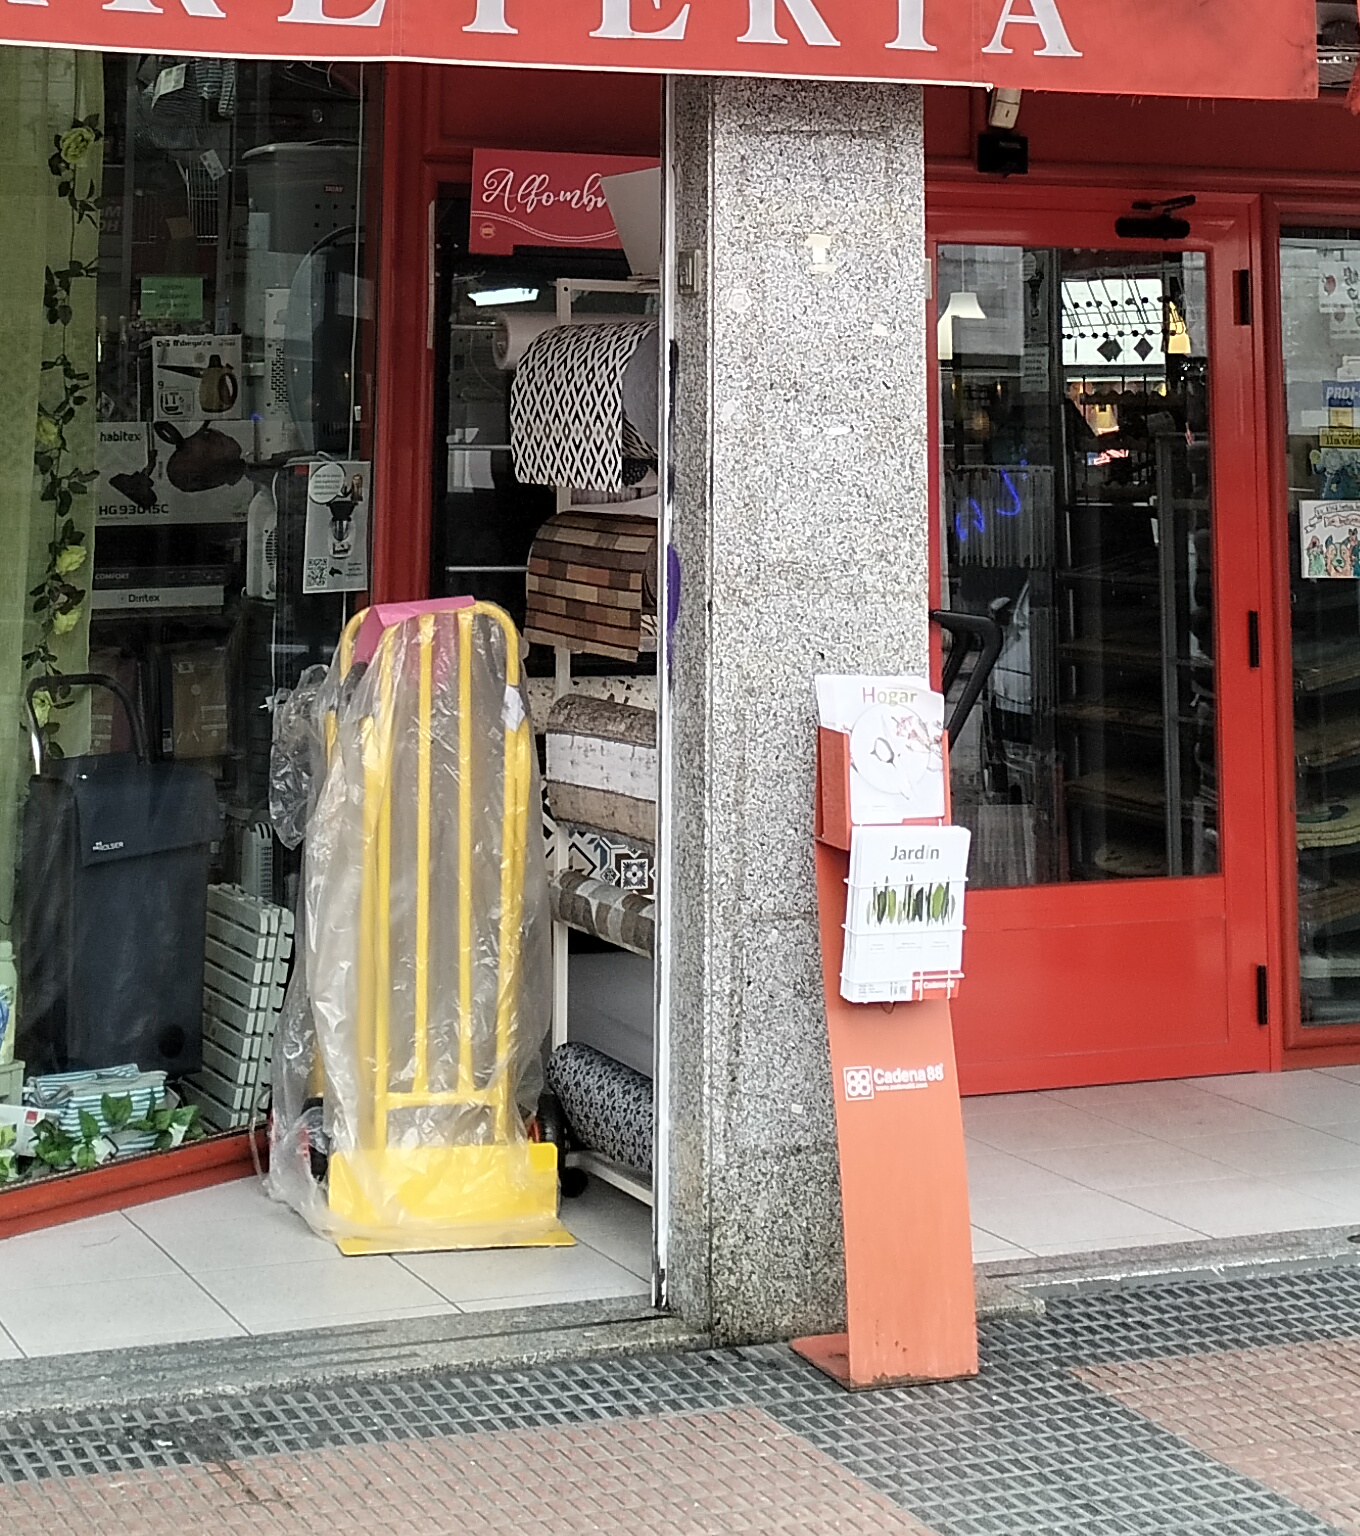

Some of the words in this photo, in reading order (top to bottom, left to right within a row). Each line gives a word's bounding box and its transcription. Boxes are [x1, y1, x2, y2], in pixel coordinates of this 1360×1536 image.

[482, 168, 607, 214] Alfombr
[99, 427, 141, 442] habitex
[862, 686, 918, 706] Hogar
[890, 845, 939, 862] Jardín
